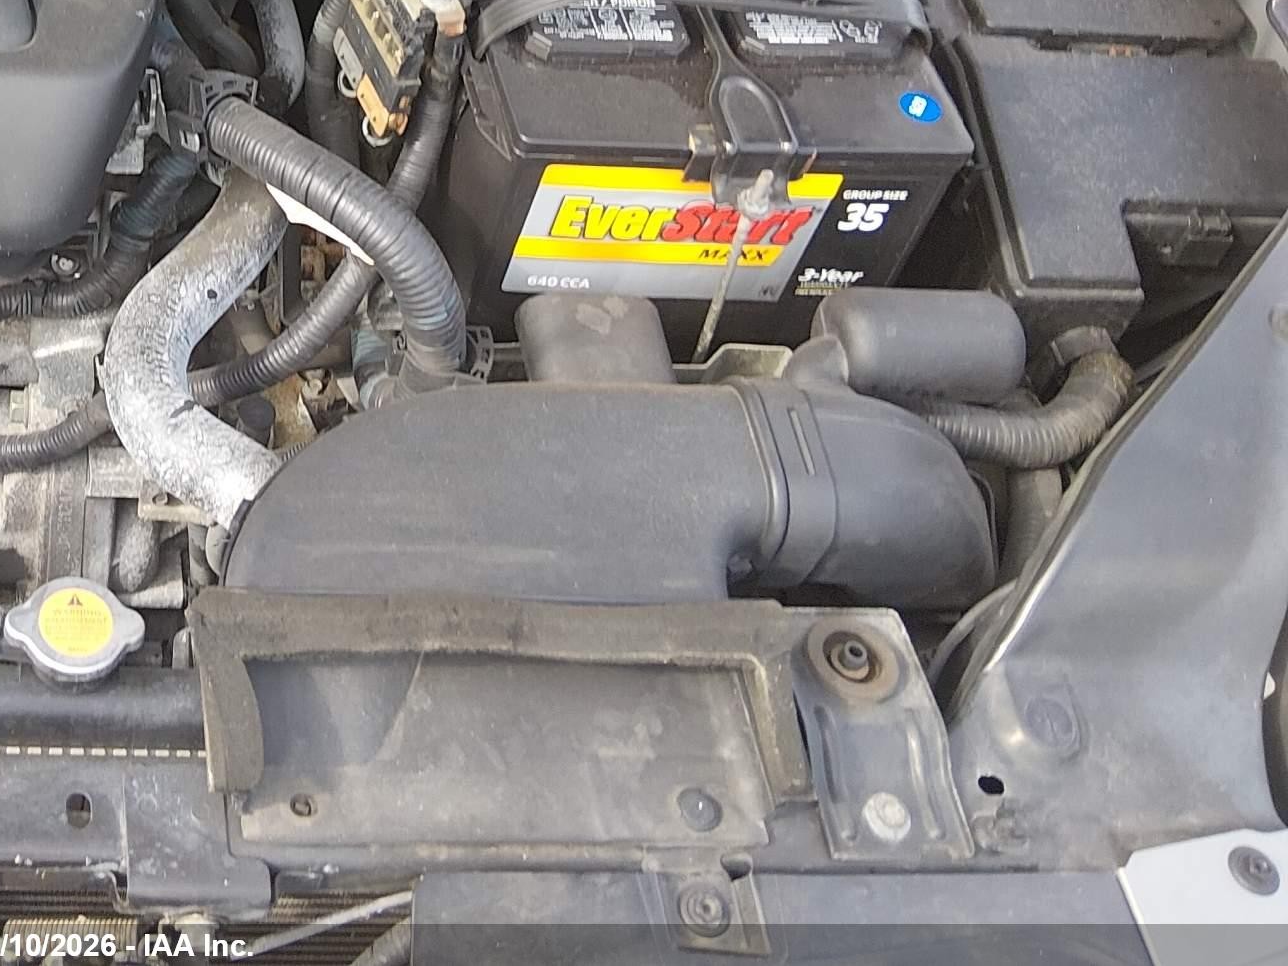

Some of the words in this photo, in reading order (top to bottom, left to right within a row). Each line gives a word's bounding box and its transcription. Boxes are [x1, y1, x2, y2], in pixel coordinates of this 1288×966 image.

[842, 189, 883, 201] GROUP
[883, 189, 909, 201] SIZE
[837, 202, 891, 232] 35
[527, 274, 559, 288] 640
[559, 276, 591, 290] CCA
